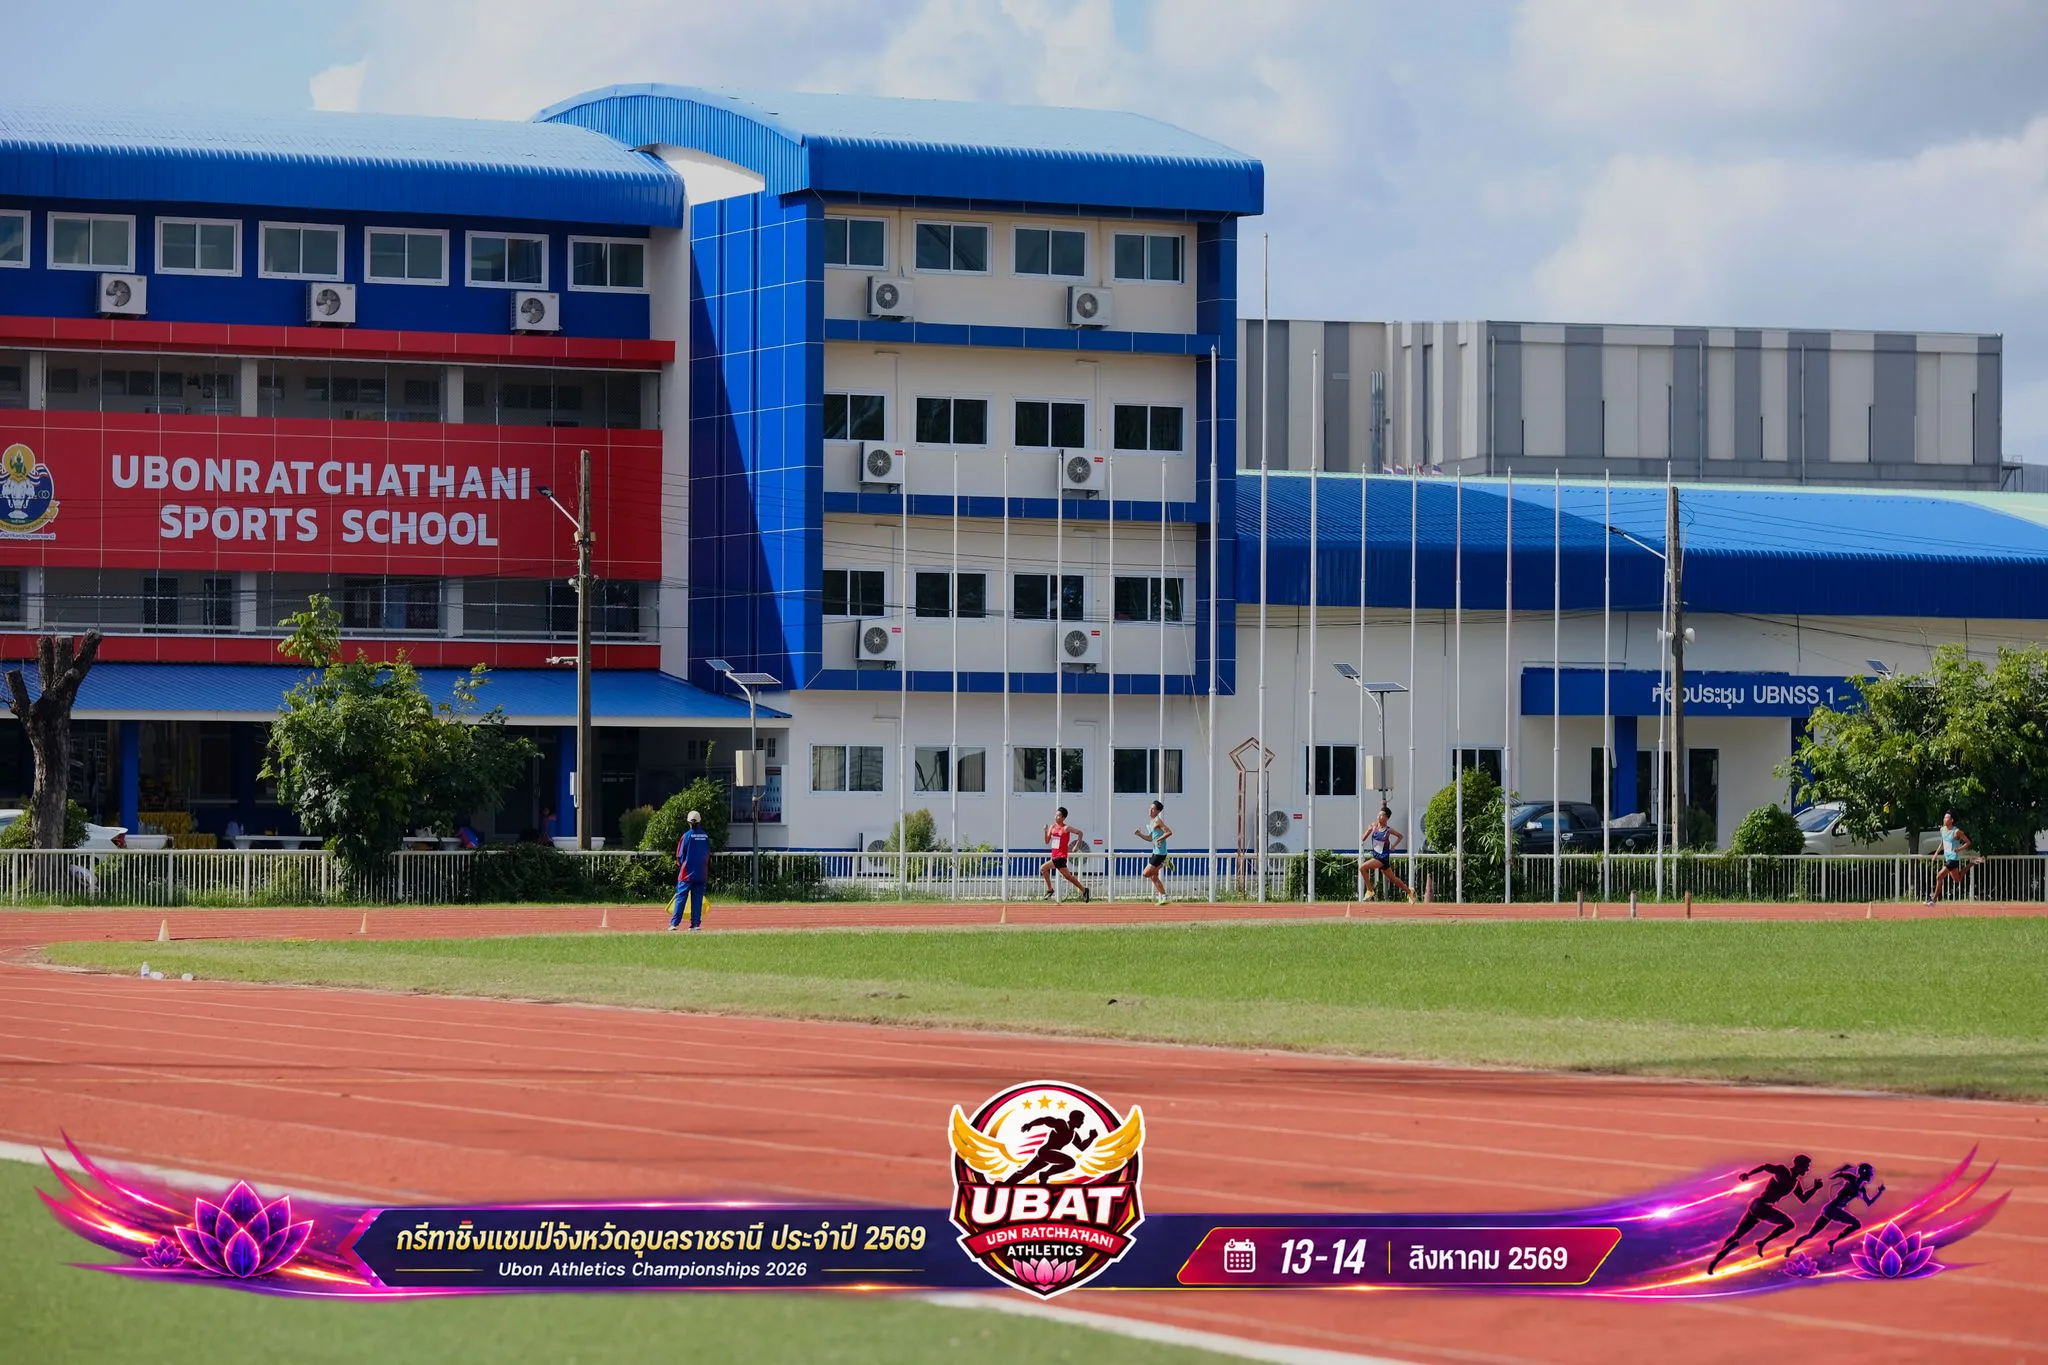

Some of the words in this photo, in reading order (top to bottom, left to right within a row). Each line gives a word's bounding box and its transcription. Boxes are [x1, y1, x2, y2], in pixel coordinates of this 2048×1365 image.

[112, 454, 530, 500] UBONRATCHATHANI
[160, 504, 318, 542] SPORTS
[342, 509, 498, 546] SCHOOL
[1753, 685, 1820, 705] UBNSS
[1826, 686, 1835, 705] 1
